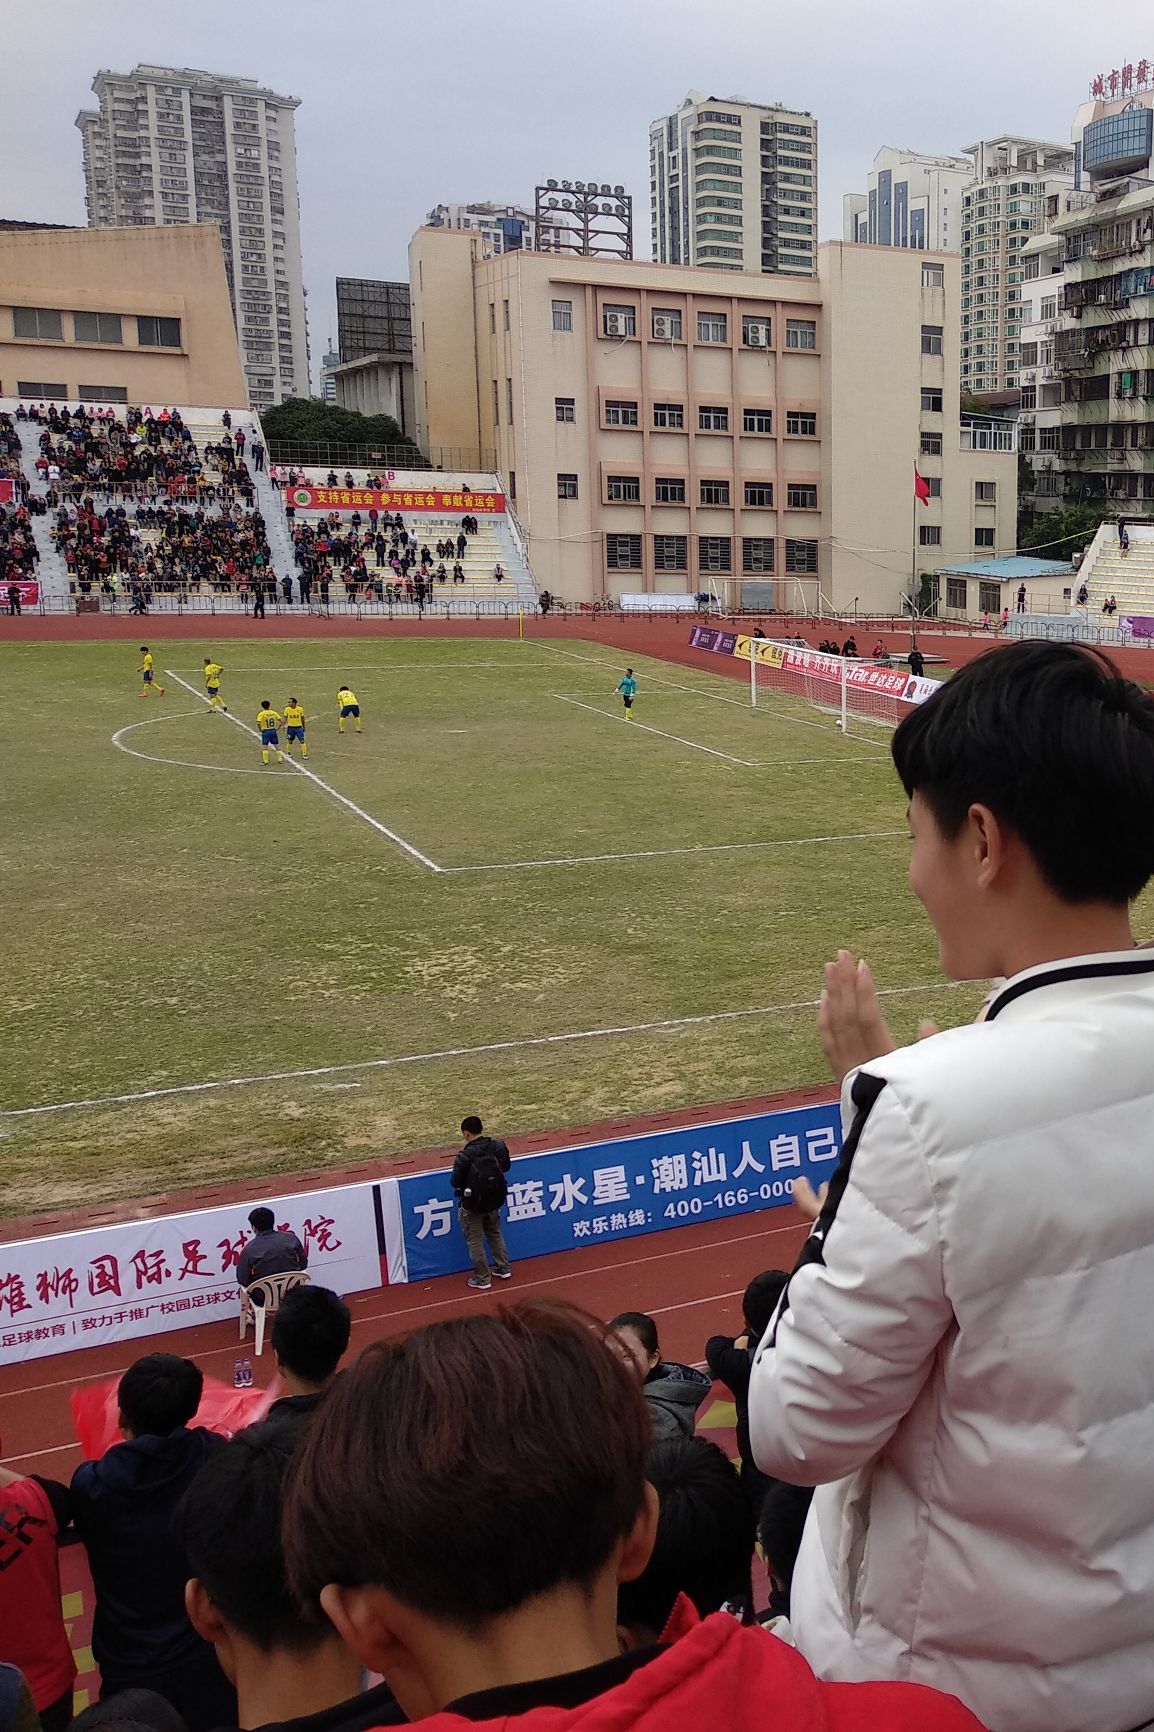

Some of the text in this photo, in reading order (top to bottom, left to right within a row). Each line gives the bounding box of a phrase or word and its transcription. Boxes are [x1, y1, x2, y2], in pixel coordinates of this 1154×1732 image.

[387, 471, 396, 481] B
[316, 490, 496, 507] 支持省运会 参与省运会 奉献省运会
[414, 1126, 839, 1241] 方蓝水星·潮汕人自己
[0, 1214, 342, 1318] 雄狮国际足球院
[0, 1322, 66, 1349] 足球教育
